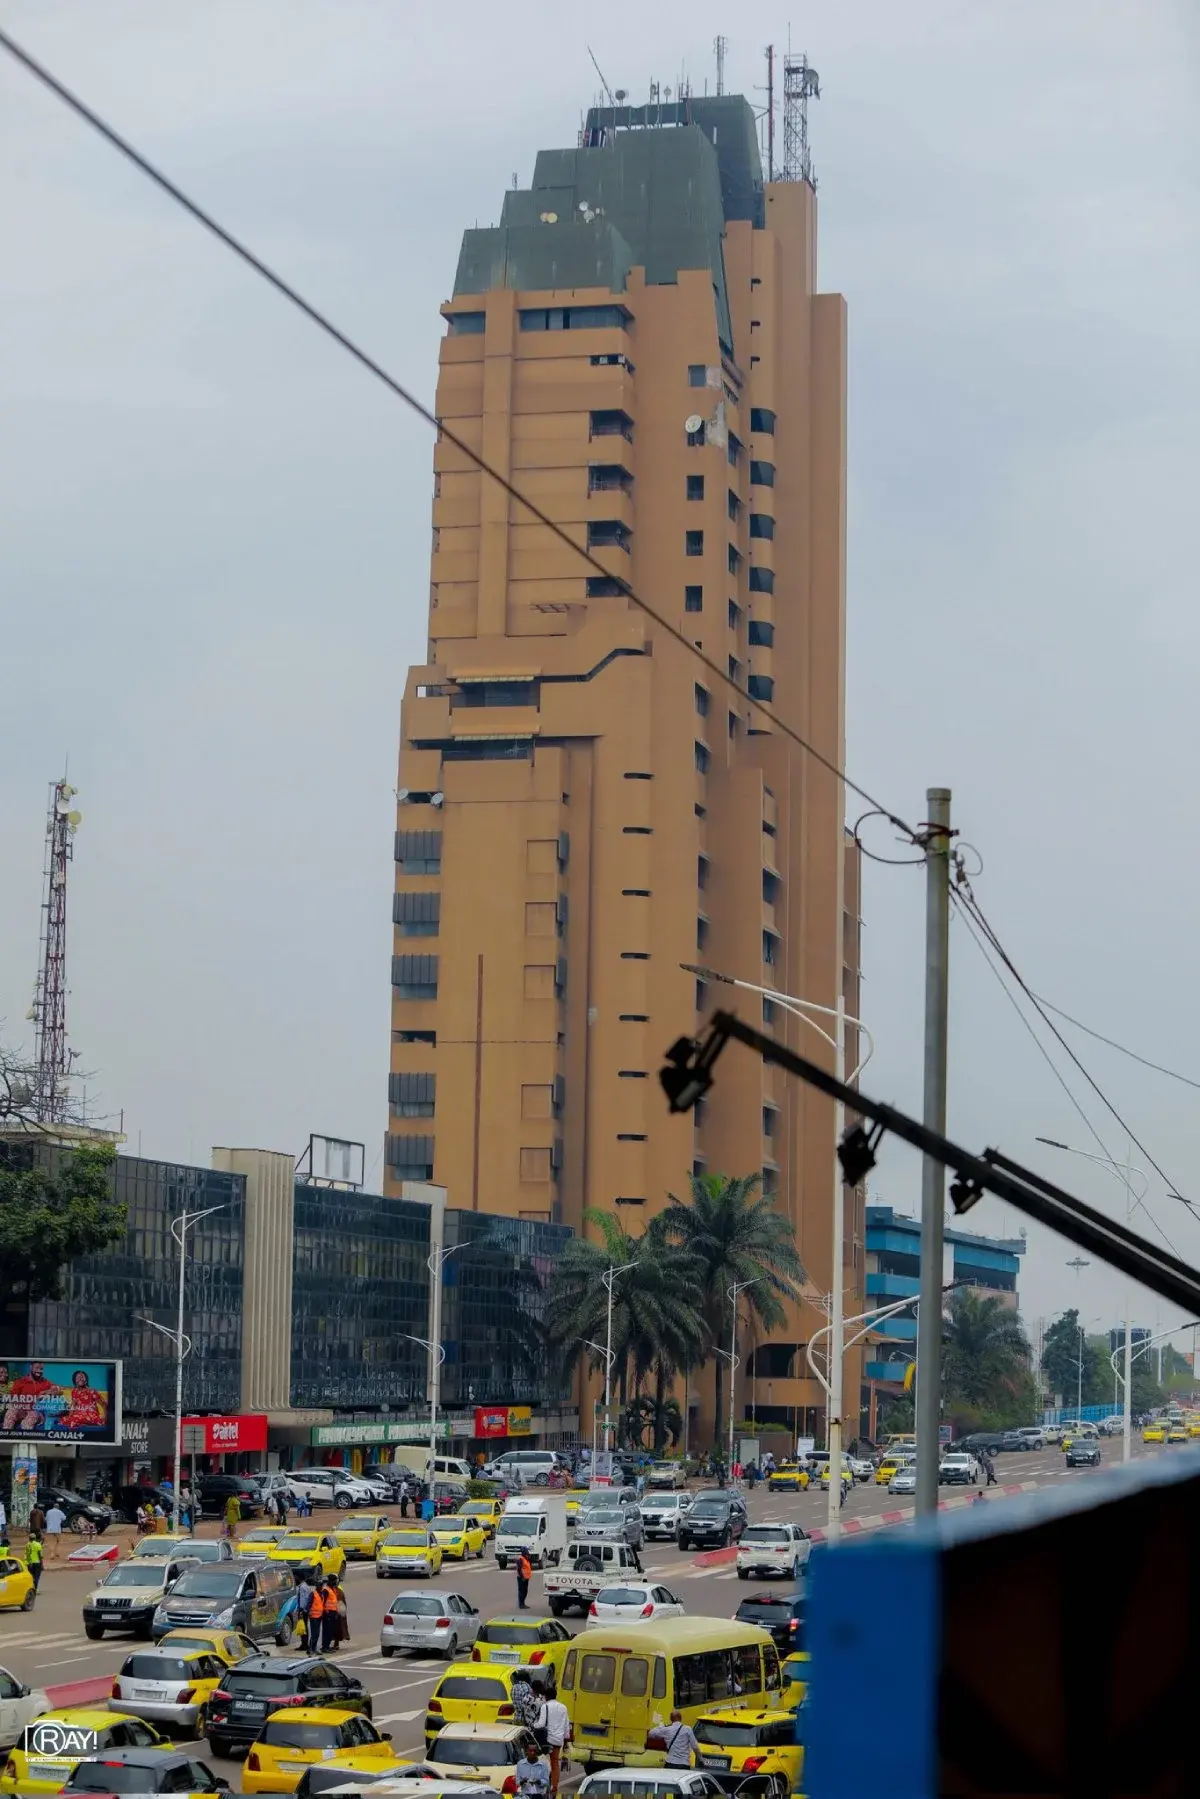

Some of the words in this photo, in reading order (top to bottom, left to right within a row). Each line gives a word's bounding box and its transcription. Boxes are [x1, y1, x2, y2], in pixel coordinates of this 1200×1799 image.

[2, 1394, 37, 1404] MARDI
[47, 1430, 85, 1440] CANAL+
[121, 1422, 149, 1440] ANAL+
[219, 1421, 239, 1440] airtel
[131, 1441, 148, 1454] STORE
[555, 1577, 593, 1586] TOYOTA
